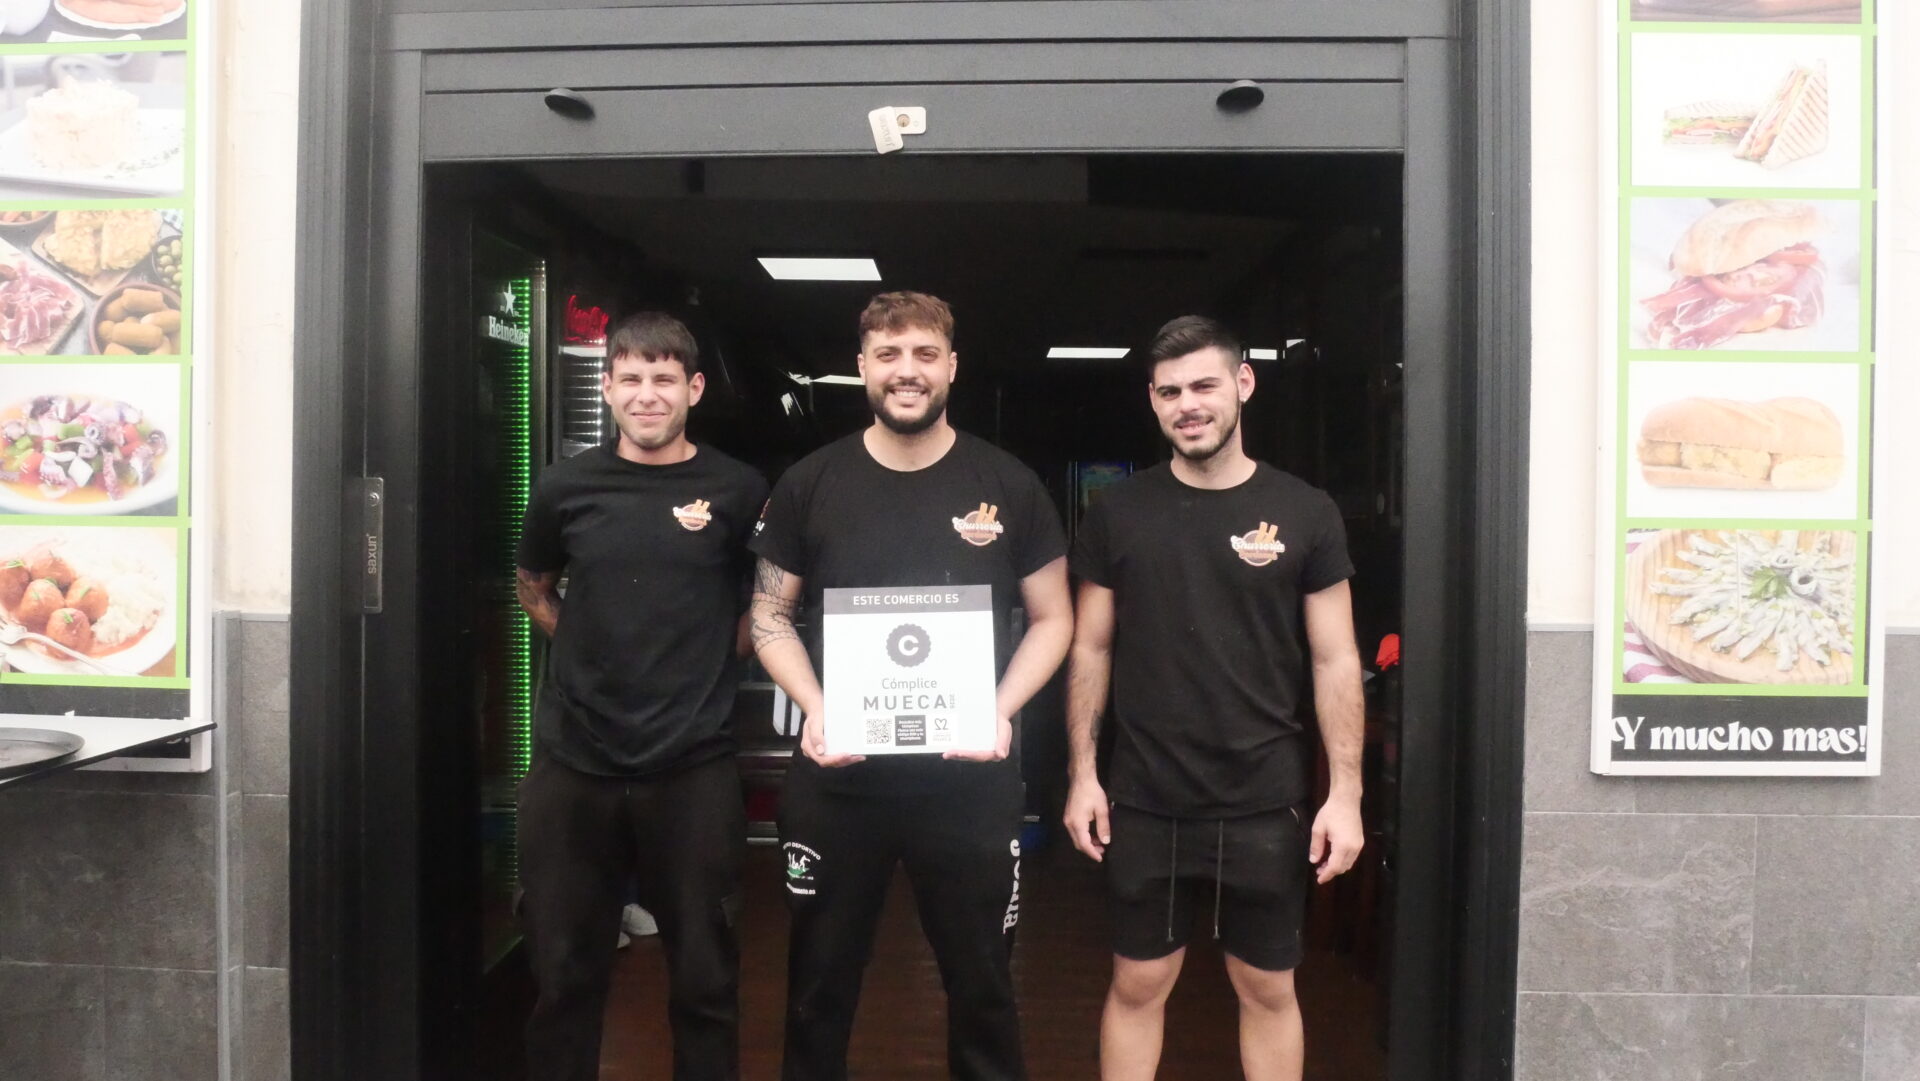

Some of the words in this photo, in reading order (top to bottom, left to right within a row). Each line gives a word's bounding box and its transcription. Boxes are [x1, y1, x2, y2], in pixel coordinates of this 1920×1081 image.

[367, 535, 377, 575] saxun
[853, 595, 881, 605] ESTE
[884, 594, 942, 604] COMERCIO
[945, 593, 959, 603] ES
[882, 678, 937, 692] Cómplice
[863, 694, 947, 711] MUECA
[1610, 716, 1646, 750] Y
[1650, 721, 1773, 751] mucho
[1782, 725, 1867, 755] mas!
[791, 842, 821, 860] DEPORTIVO
